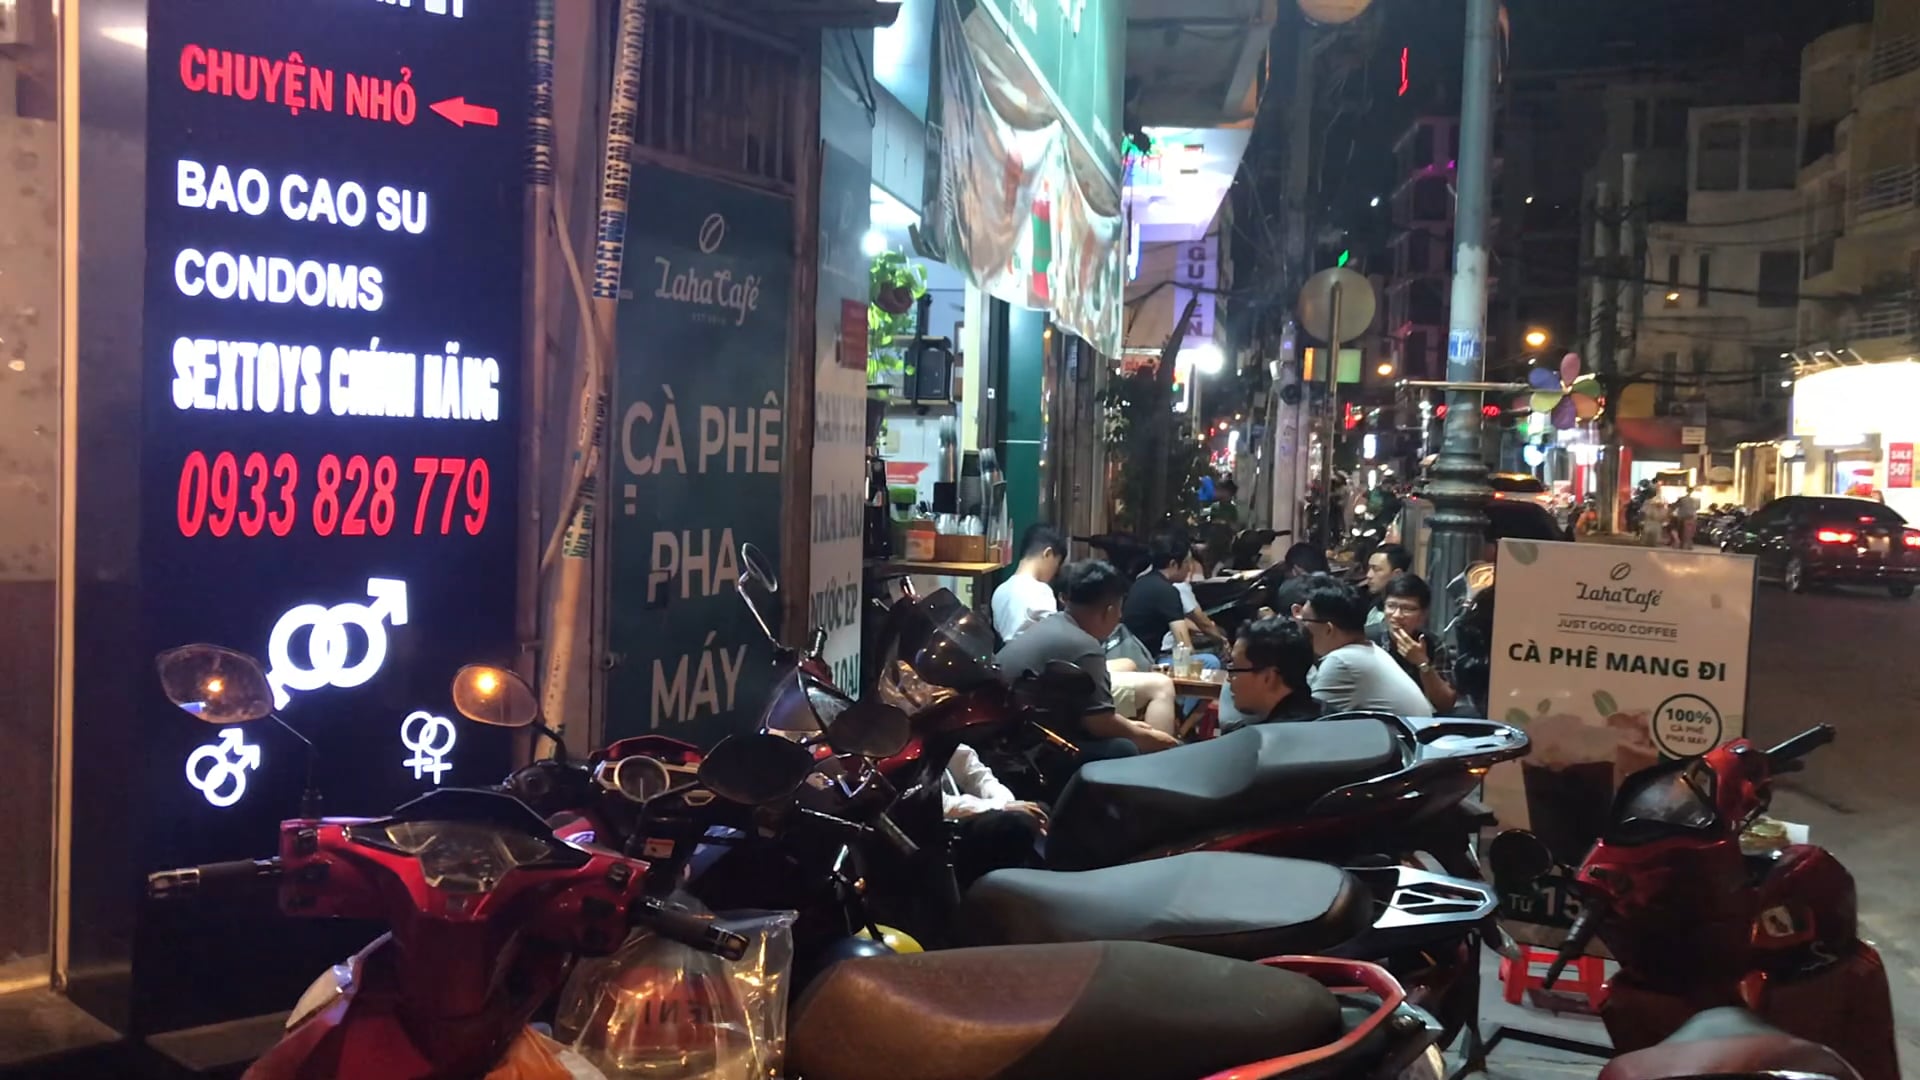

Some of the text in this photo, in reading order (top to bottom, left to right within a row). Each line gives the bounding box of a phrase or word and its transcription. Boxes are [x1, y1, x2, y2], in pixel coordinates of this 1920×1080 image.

[180, 44, 416, 125] CHUYỆN NHỎ
[177, 160, 428, 234] BAO CAO SU
[174, 248, 384, 312] CONDOMS
[714, 269, 761, 326] Café
[172, 336, 322, 415] SEXTOYS
[622, 384, 687, 475] CÀ
[698, 390, 782, 474] PHÊ
[177, 450, 298, 537] 0933
[312, 454, 397, 536] 828
[413, 457, 489, 536] 779
[648, 528, 741, 602] PHA
[1576, 582, 1664, 613] Laha Café
[1508, 639, 1727, 682] CÀ PHÊ MANG ĐI
[1557, 618, 1678, 639] JUST GOOD COFFEE
[651, 630, 747, 729] MÁY
[1665, 708, 1713, 725] 100%
